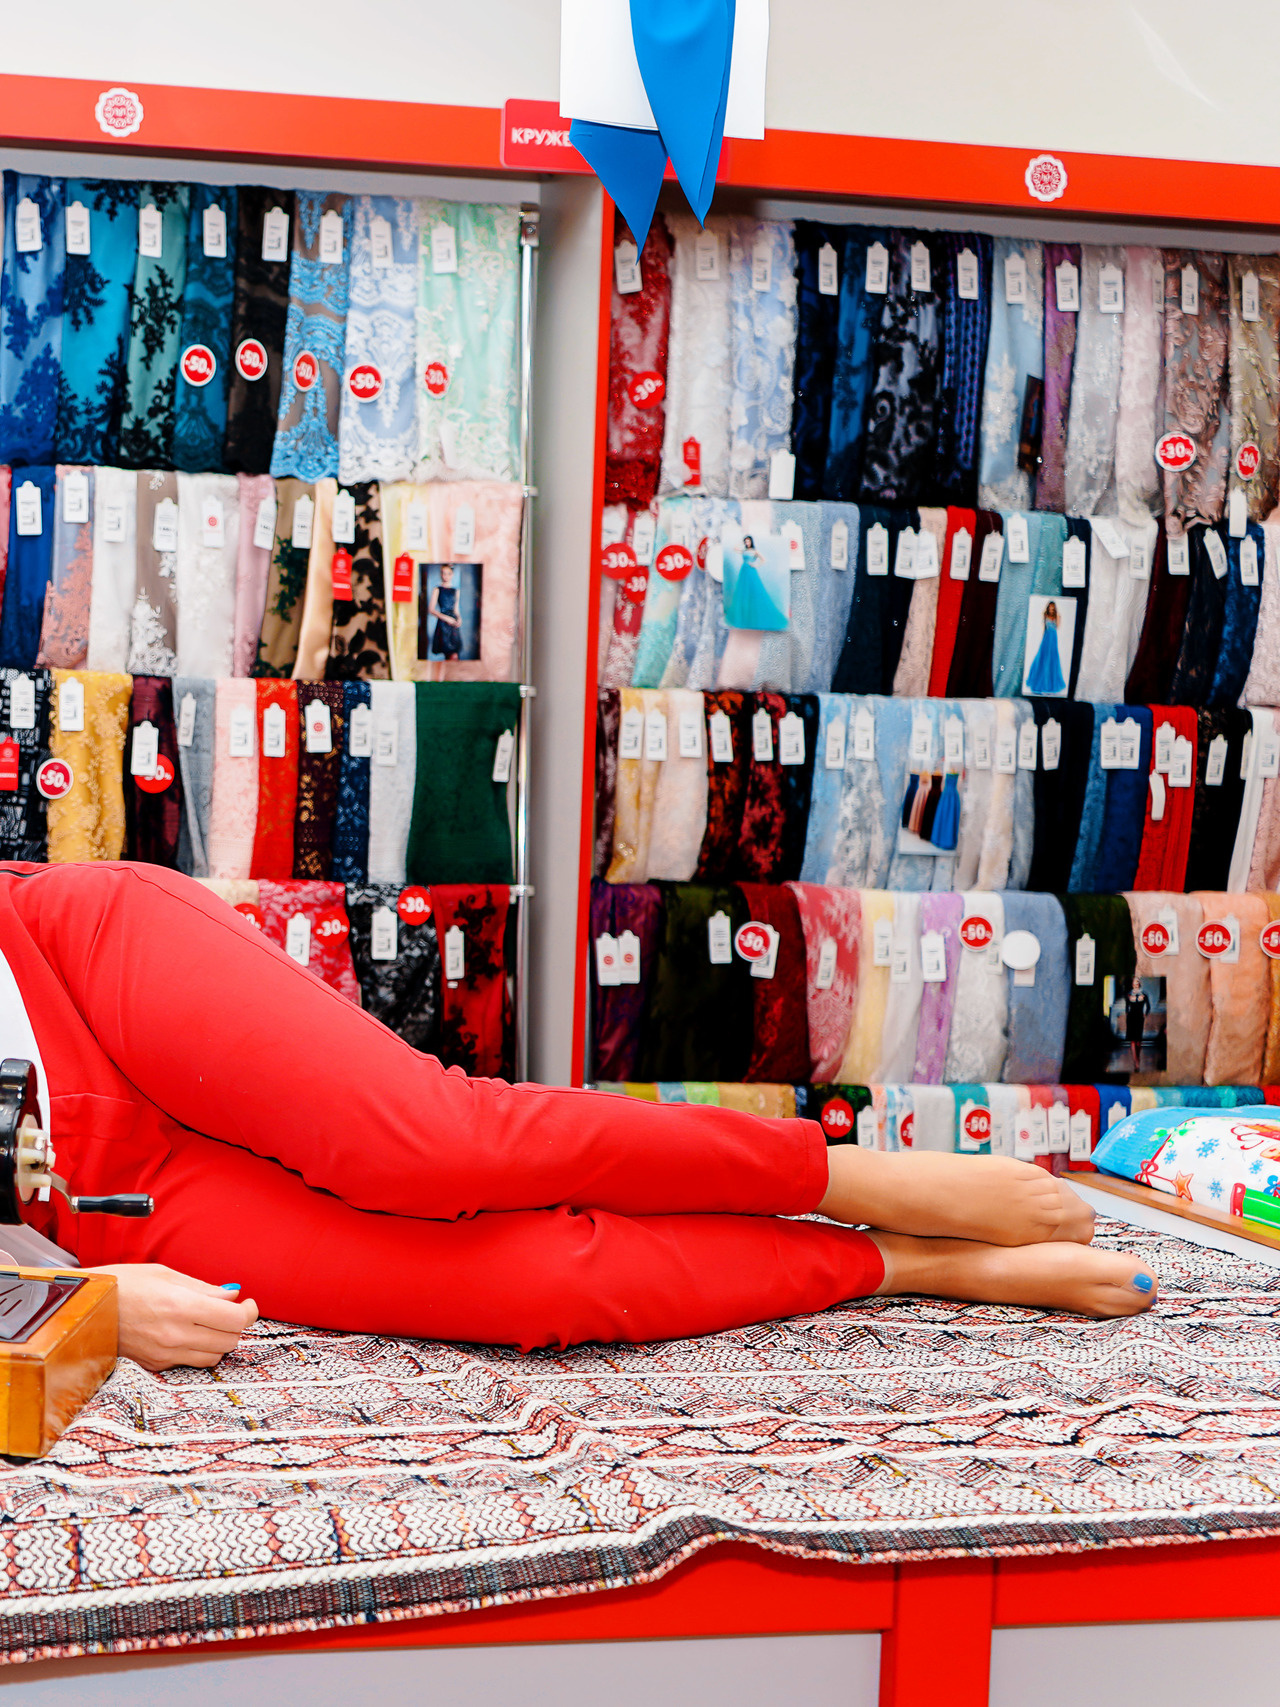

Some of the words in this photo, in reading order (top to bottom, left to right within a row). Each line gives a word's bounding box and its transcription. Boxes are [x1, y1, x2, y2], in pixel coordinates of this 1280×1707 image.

[185, 355, 213, 375] -50%
[351, 372, 381, 390] -50%
[633, 378, 663, 402] -30%
[602, 552, 637, 569] -30%
[659, 552, 693, 571] -30%
[627, 575, 646, 592] -30
[41, 769, 69, 790] -50%
[399, 896, 431, 913] -30%
[316, 919, 348, 937] -30%
[962, 924, 992, 941] -50%
[1198, 931, 1230, 947] -50%
[965, 1117, 990, 1133] -50
